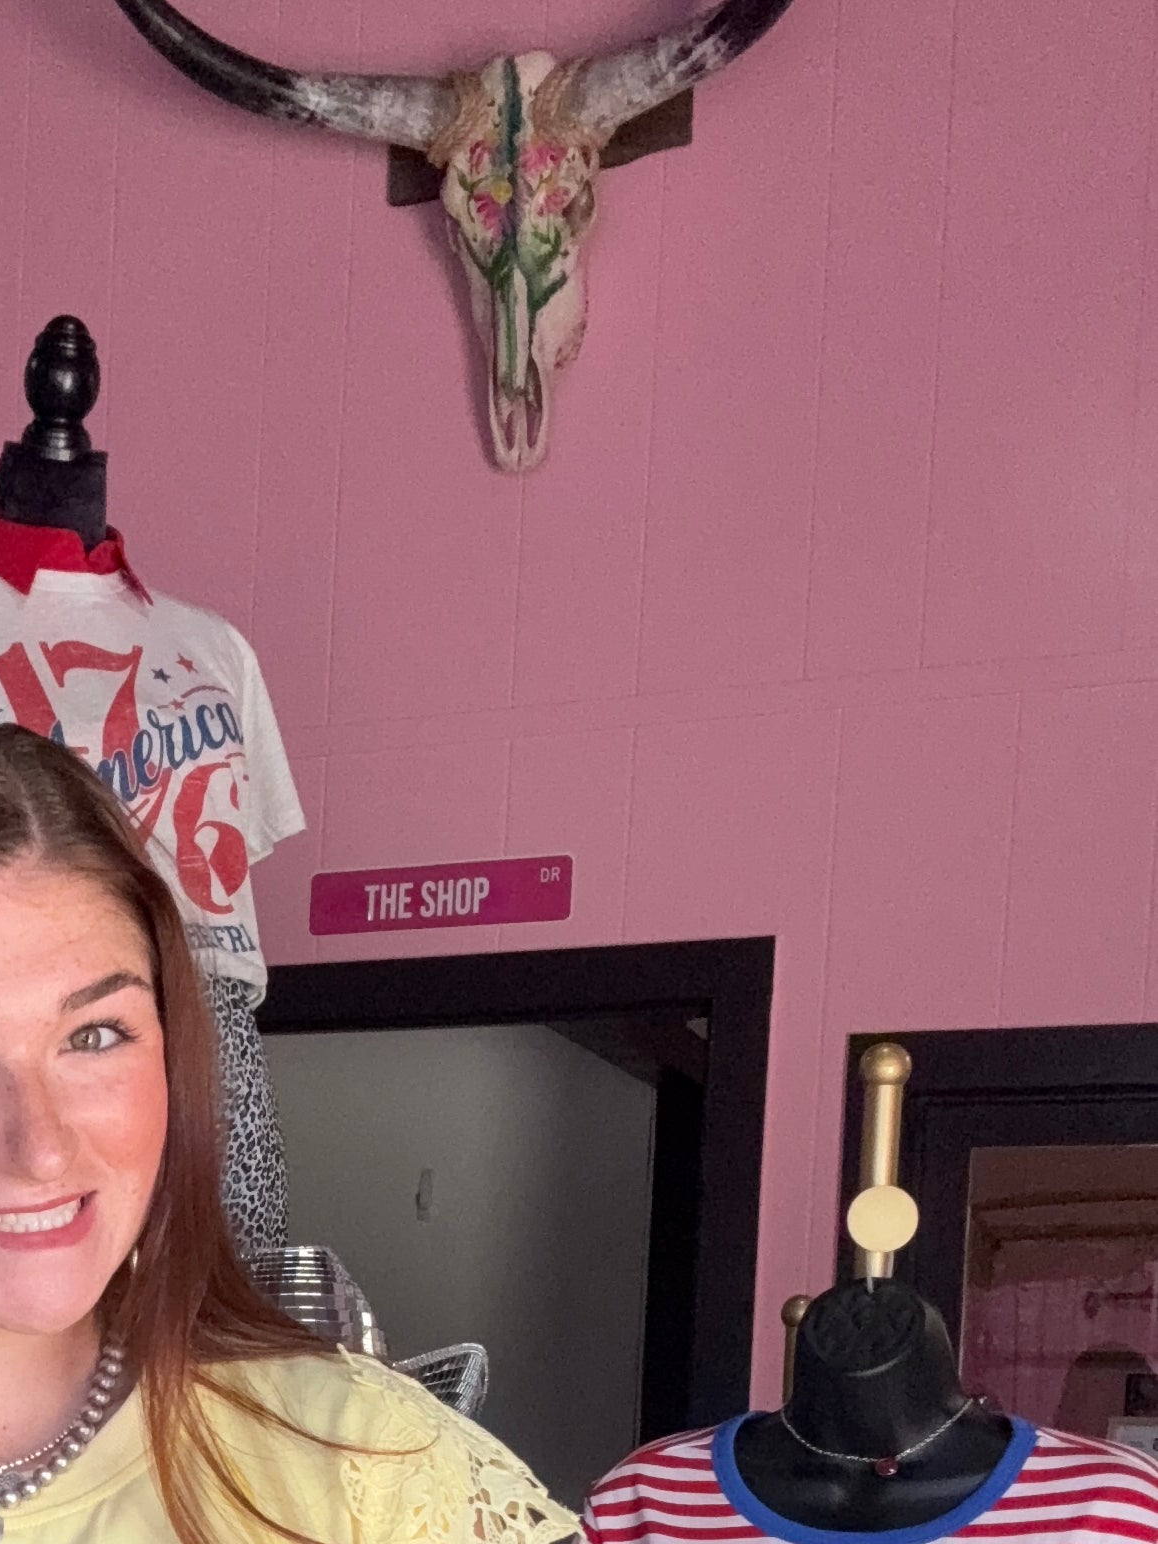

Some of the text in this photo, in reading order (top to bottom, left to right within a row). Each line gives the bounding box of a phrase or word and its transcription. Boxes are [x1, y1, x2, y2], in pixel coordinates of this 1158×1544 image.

[364, 867, 560, 922] THE SHOP DR
